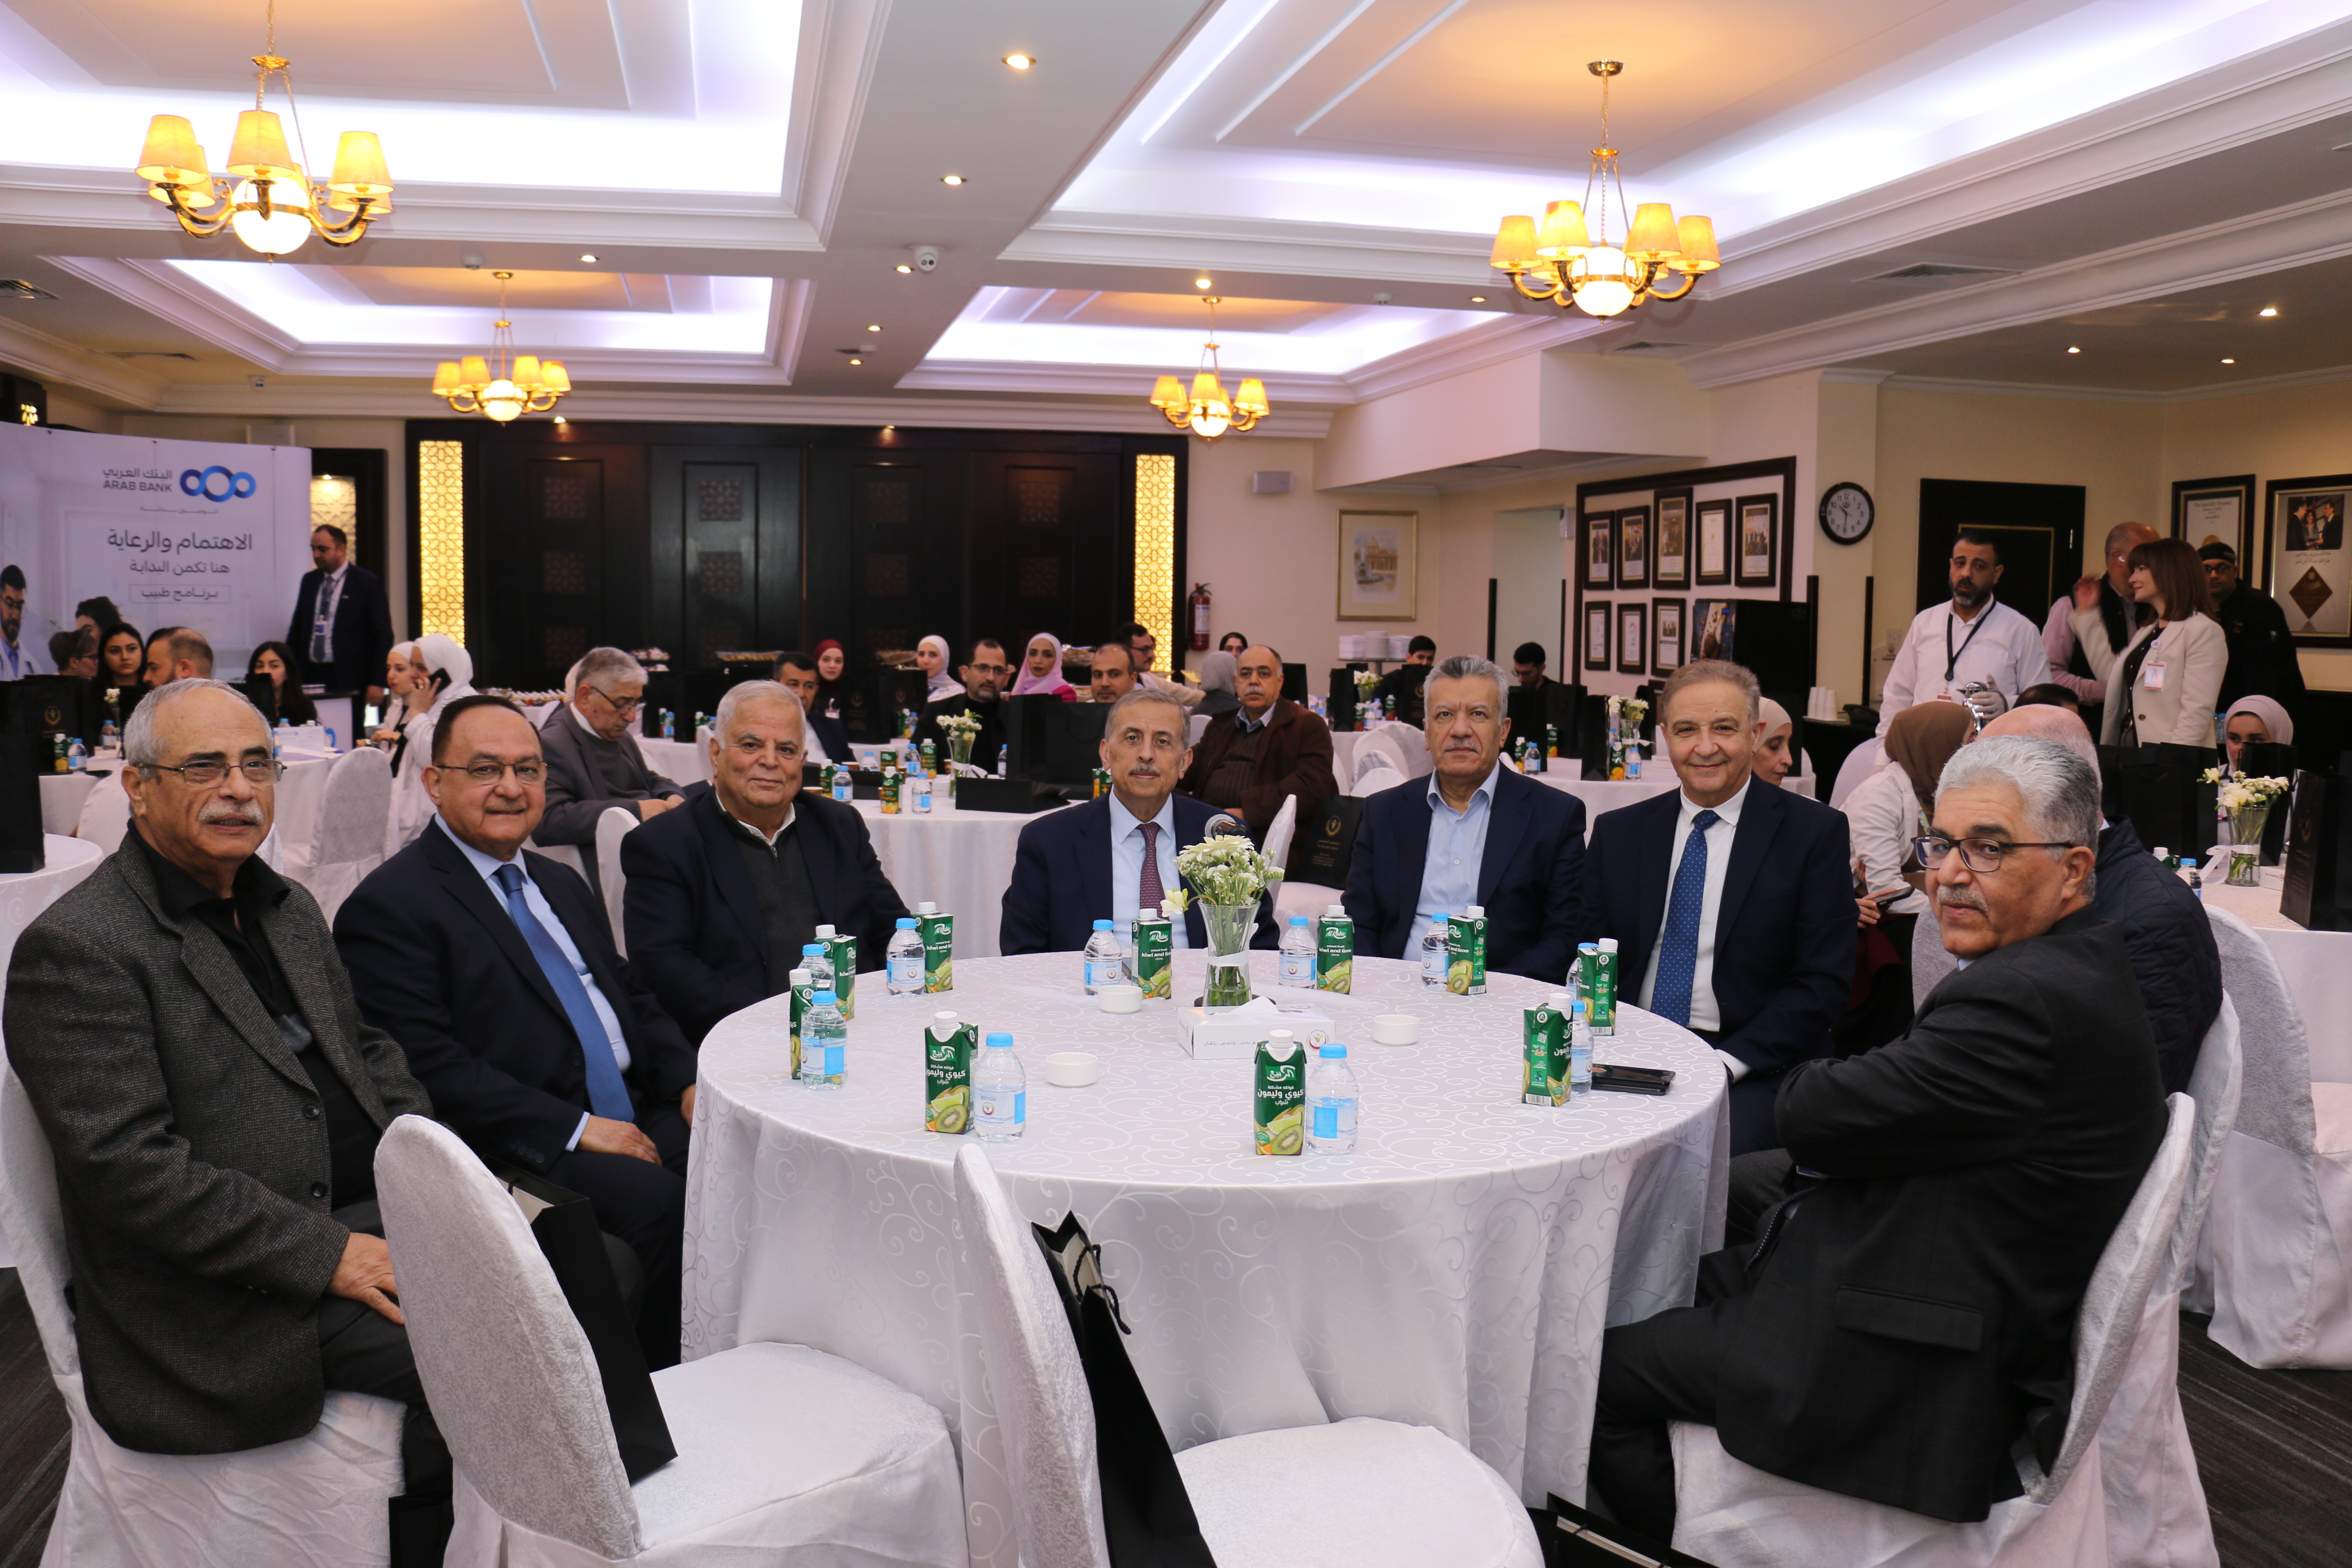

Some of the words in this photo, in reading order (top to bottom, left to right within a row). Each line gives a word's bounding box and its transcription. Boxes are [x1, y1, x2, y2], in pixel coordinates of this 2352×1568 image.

[103, 468, 140, 478] العربي
[143, 469, 172, 481] البنك
[103, 480, 136, 490] ARAB
[139, 482, 173, 493] BANK
[107, 529, 172, 553] والرعاية
[176, 533, 252, 555] الاهتمام
[130, 559, 169, 574] البداية
[173, 561, 207, 576] تكمن
[210, 561, 230, 573] هنا
[141, 587, 170, 600] طبيب
[173, 588, 218, 601] برنامج
[946, 1070, 966, 1080] كيوي
[1267, 1065, 1296, 1082] الربيع
[1257, 1089, 1283, 1099] وليمون
[1285, 1089, 1304, 1100] كيوي
